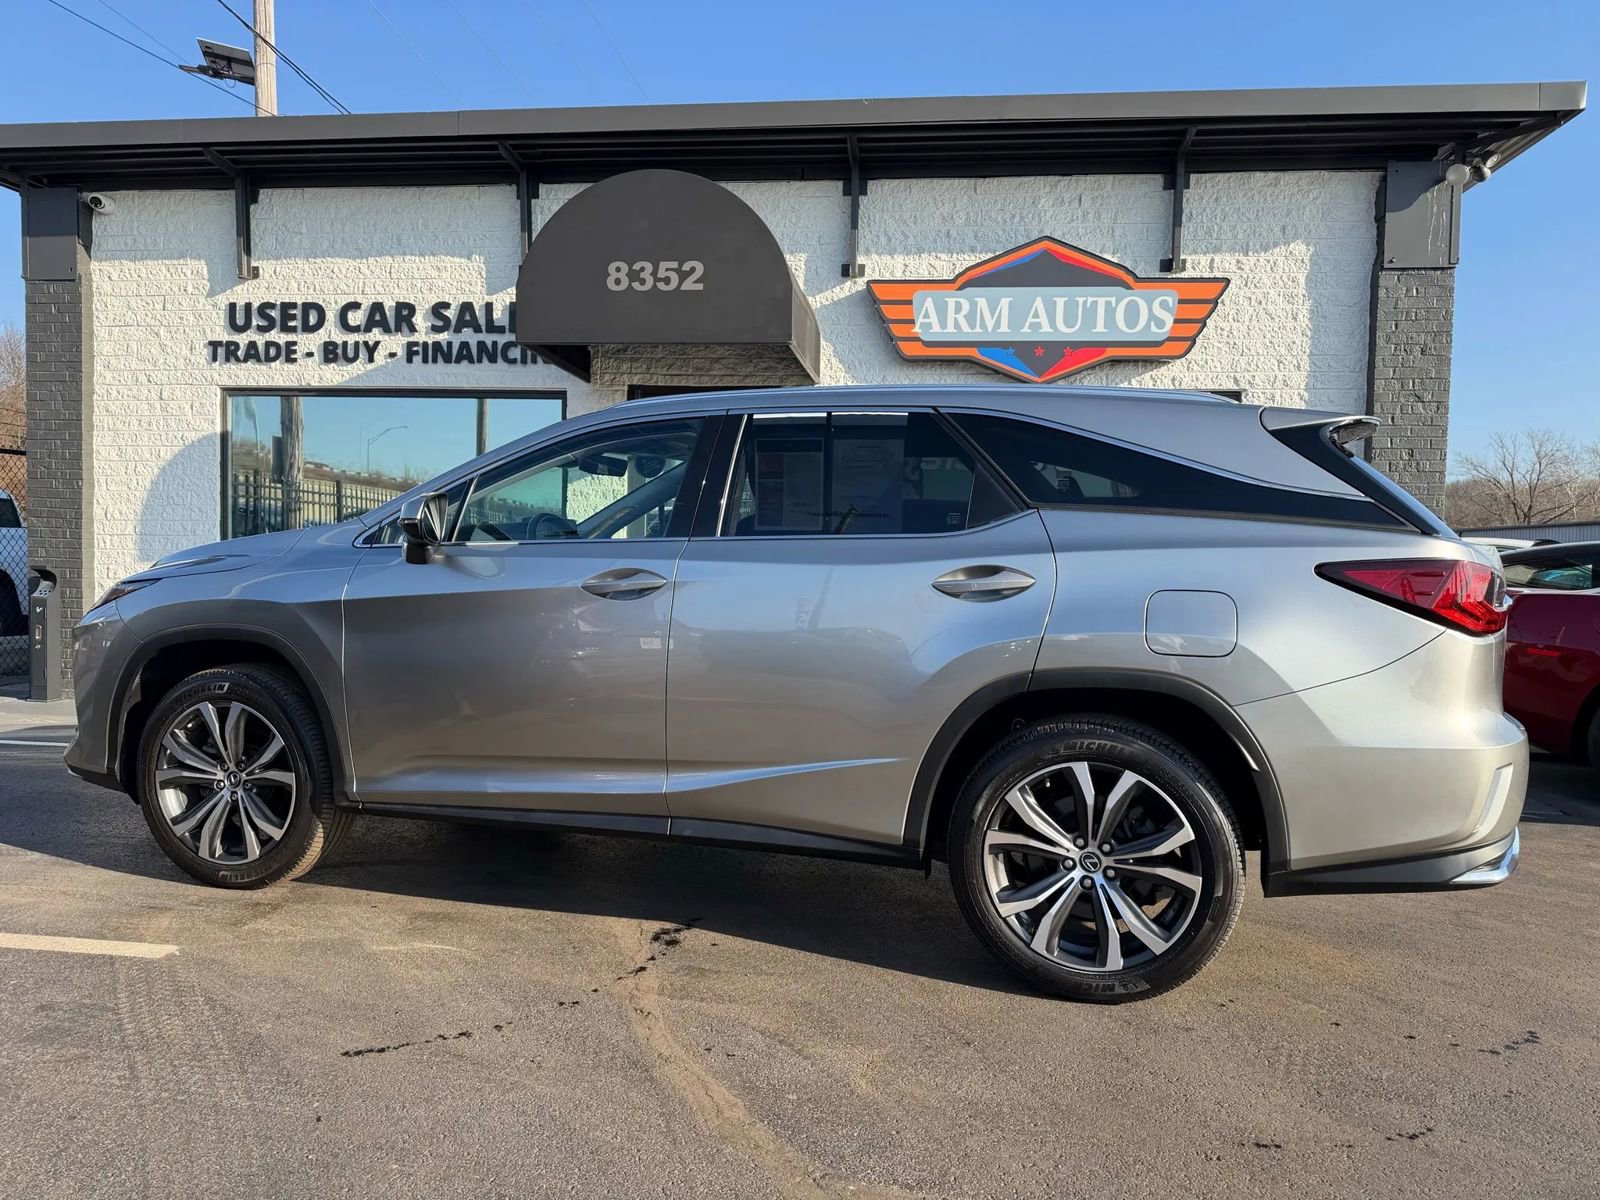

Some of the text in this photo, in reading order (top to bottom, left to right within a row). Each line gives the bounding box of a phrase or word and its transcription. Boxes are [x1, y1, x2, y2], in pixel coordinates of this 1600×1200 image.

[606, 260, 705, 292] 8352
[228, 301, 326, 334] USED
[339, 301, 418, 333] CAR
[913, 296, 1175, 334] ARM AUTOS
[208, 340, 298, 363] TRADE
[323, 340, 381, 363] BUY
